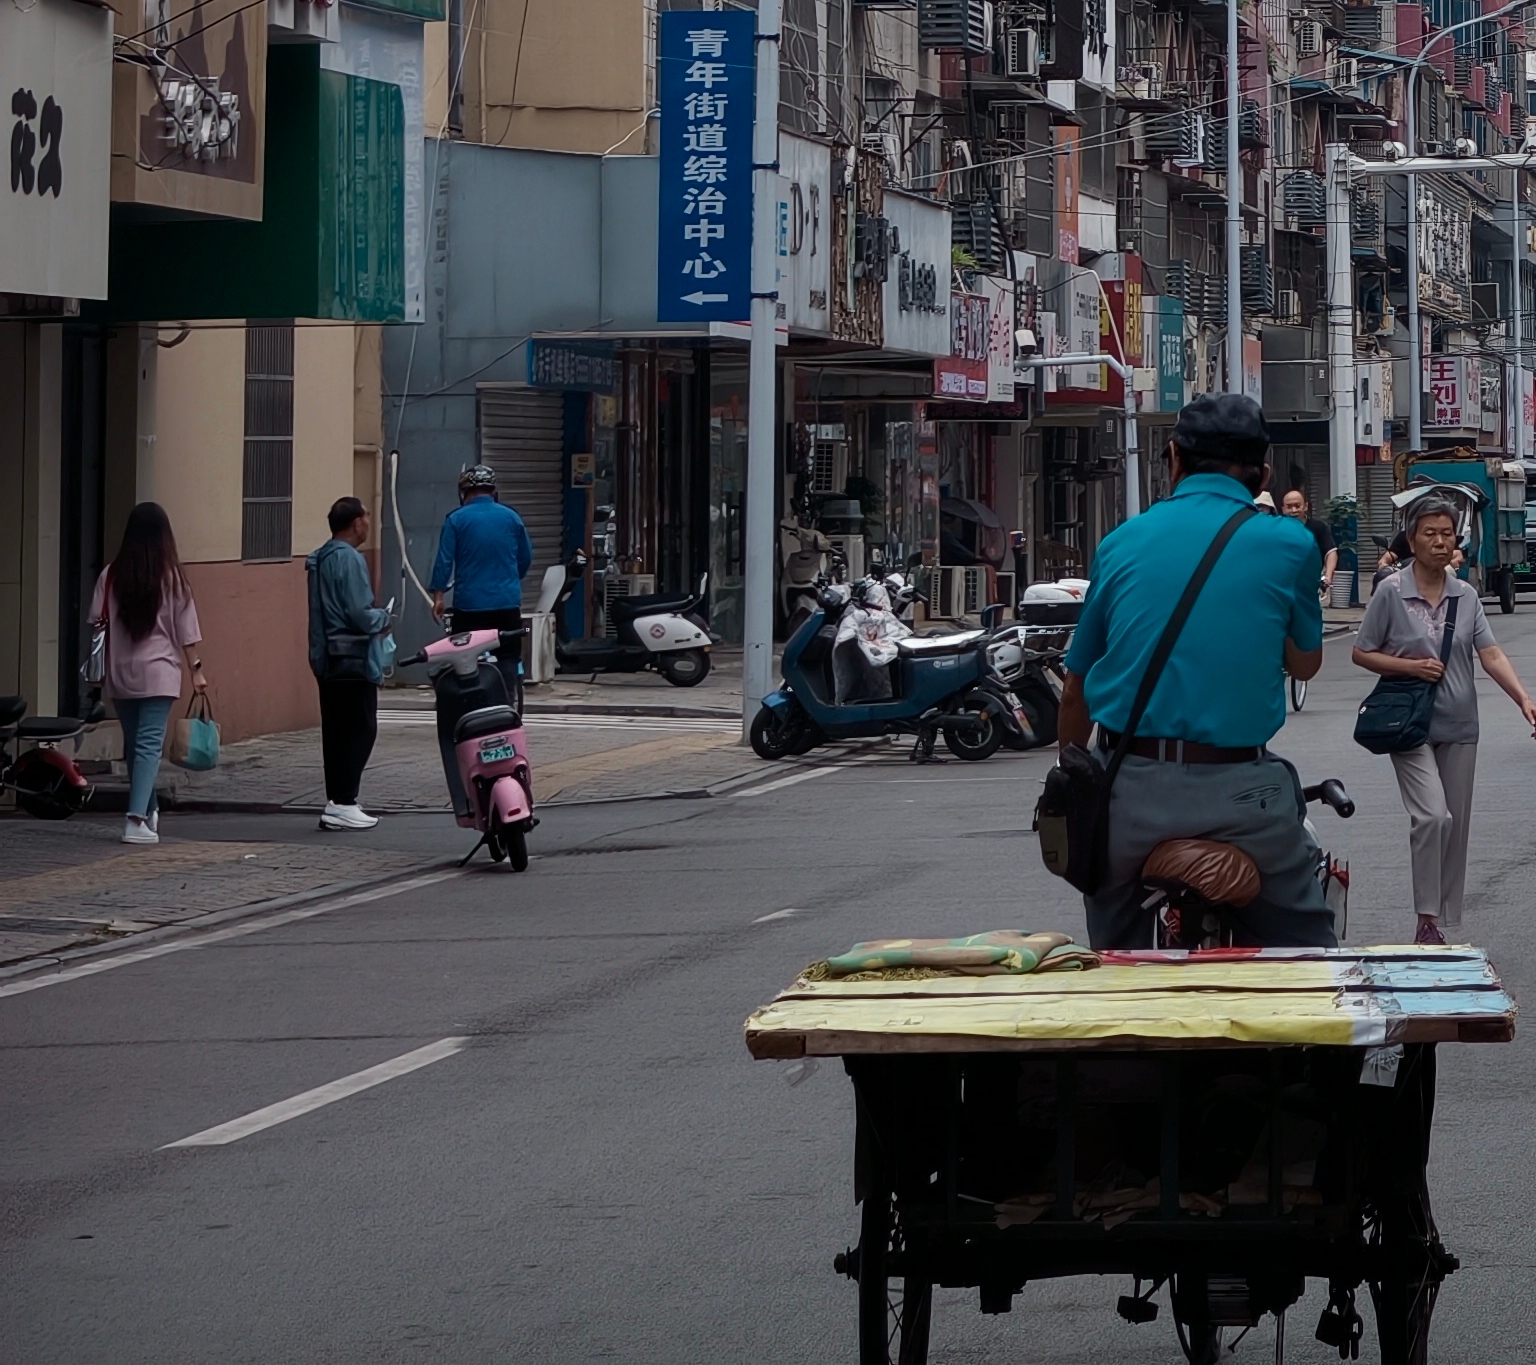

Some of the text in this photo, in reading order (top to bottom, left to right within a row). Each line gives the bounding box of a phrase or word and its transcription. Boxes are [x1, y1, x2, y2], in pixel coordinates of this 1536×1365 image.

[681, 28, 730, 280] 青年街道综治中心
